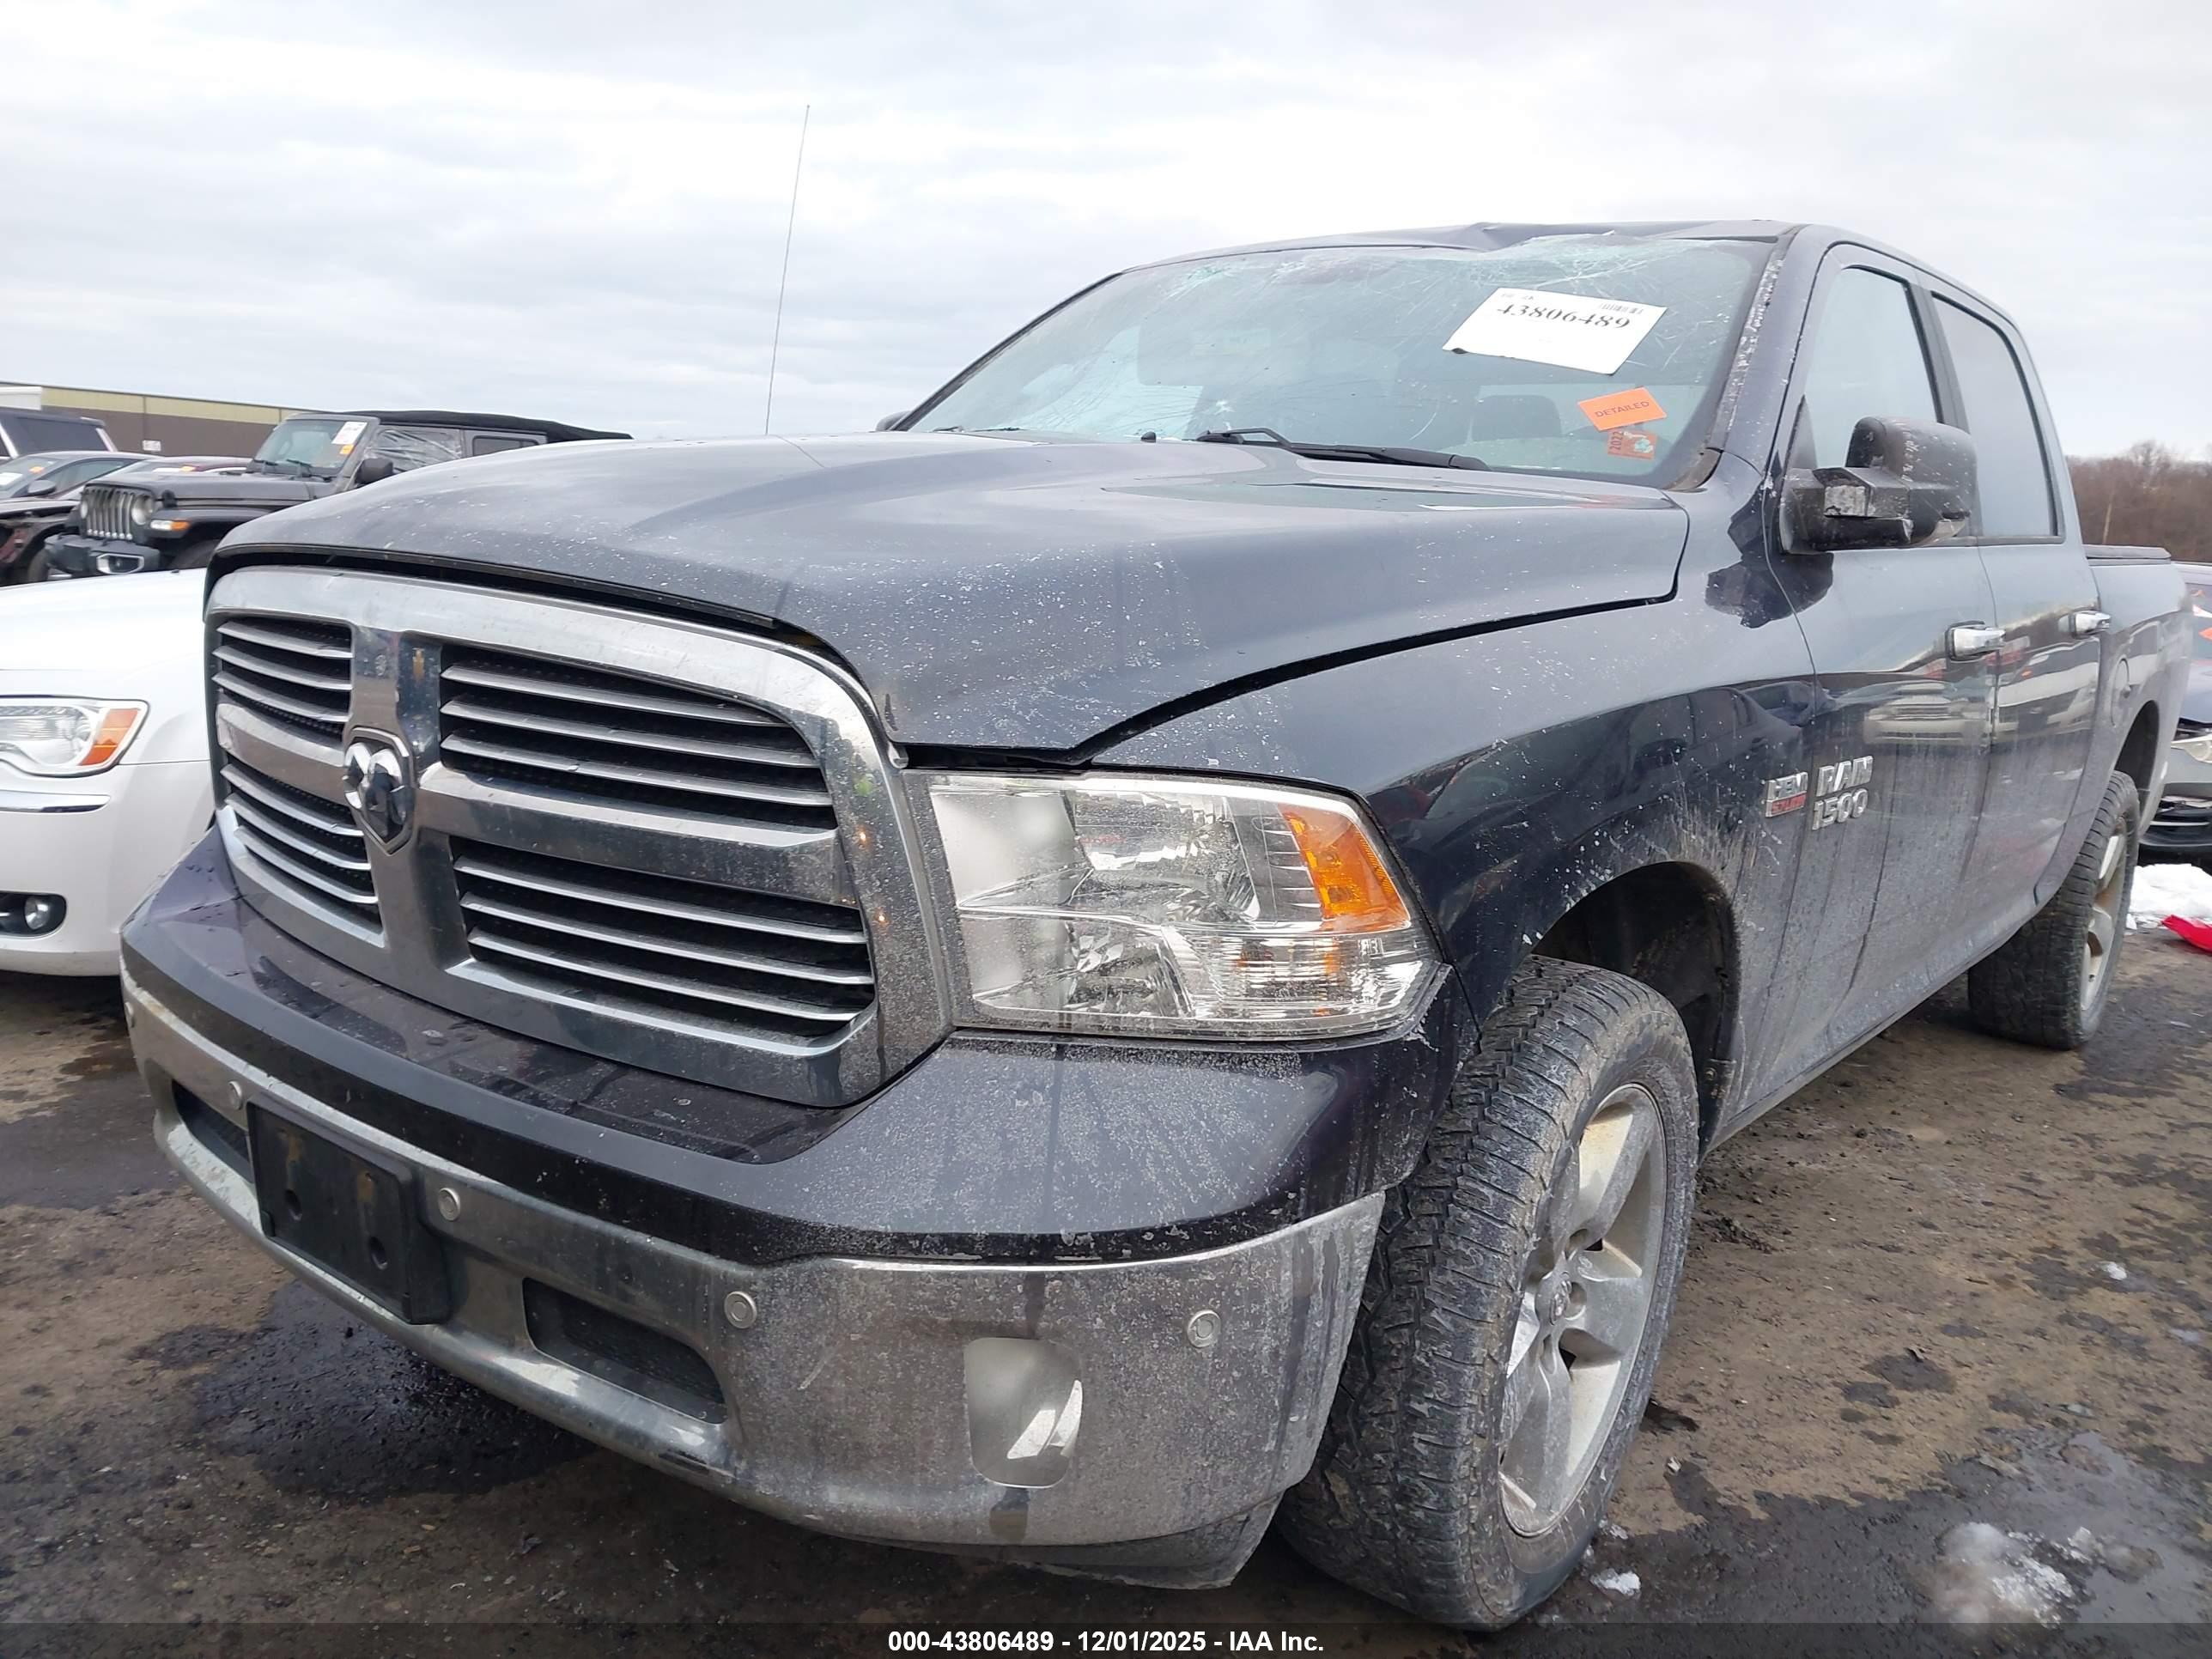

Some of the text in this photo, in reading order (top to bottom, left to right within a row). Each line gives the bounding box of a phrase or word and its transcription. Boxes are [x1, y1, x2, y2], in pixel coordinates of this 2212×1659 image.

[1497, 303, 1631, 329] 43806489
[1595, 401, 1650, 417] DETAILED
[1815, 755, 1874, 797] RAM
[1812, 787, 1869, 830] 1500
